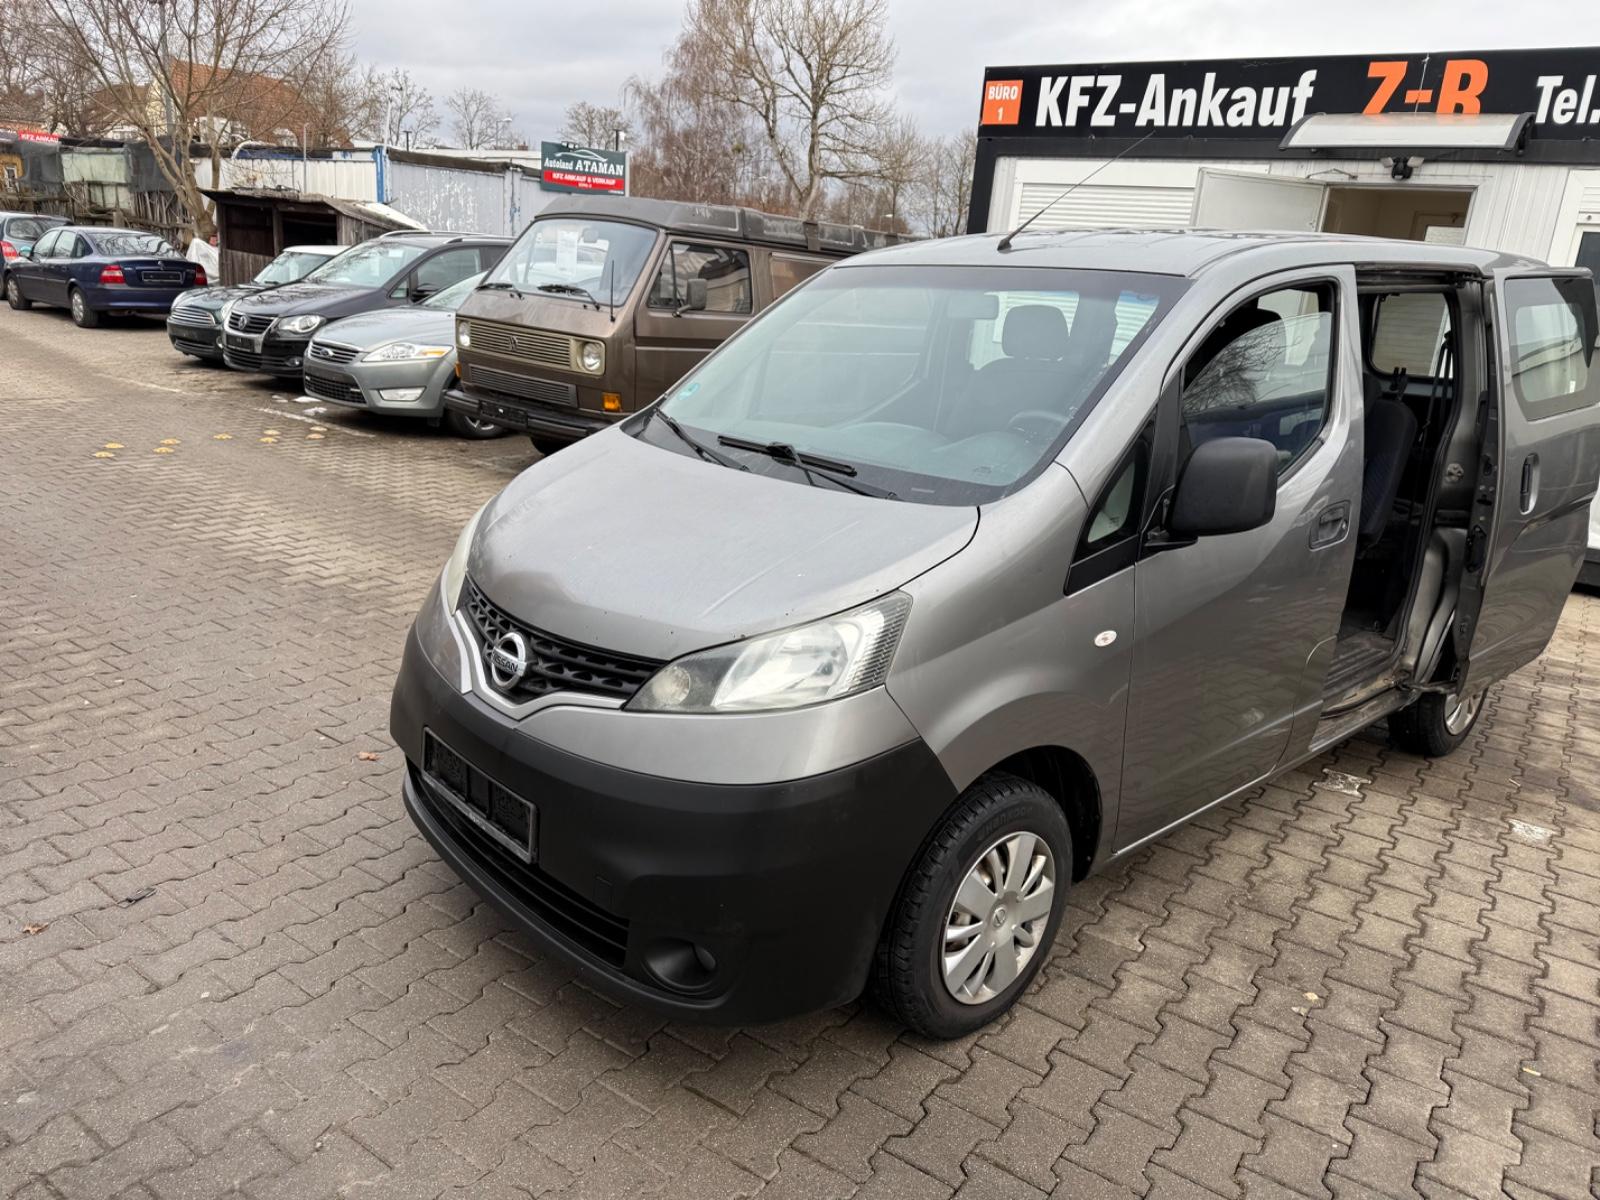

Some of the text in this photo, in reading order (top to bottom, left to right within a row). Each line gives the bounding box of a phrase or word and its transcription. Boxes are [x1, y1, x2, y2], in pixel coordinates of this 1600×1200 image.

[988, 83, 1019, 100] BÜRO
[1035, 69, 1317, 127] KFZ-Ankauf
[1535, 74, 1600, 125] Tel.
[997, 106, 1004, 121] 1
[544, 157, 624, 176] Autoland ATAMAN
